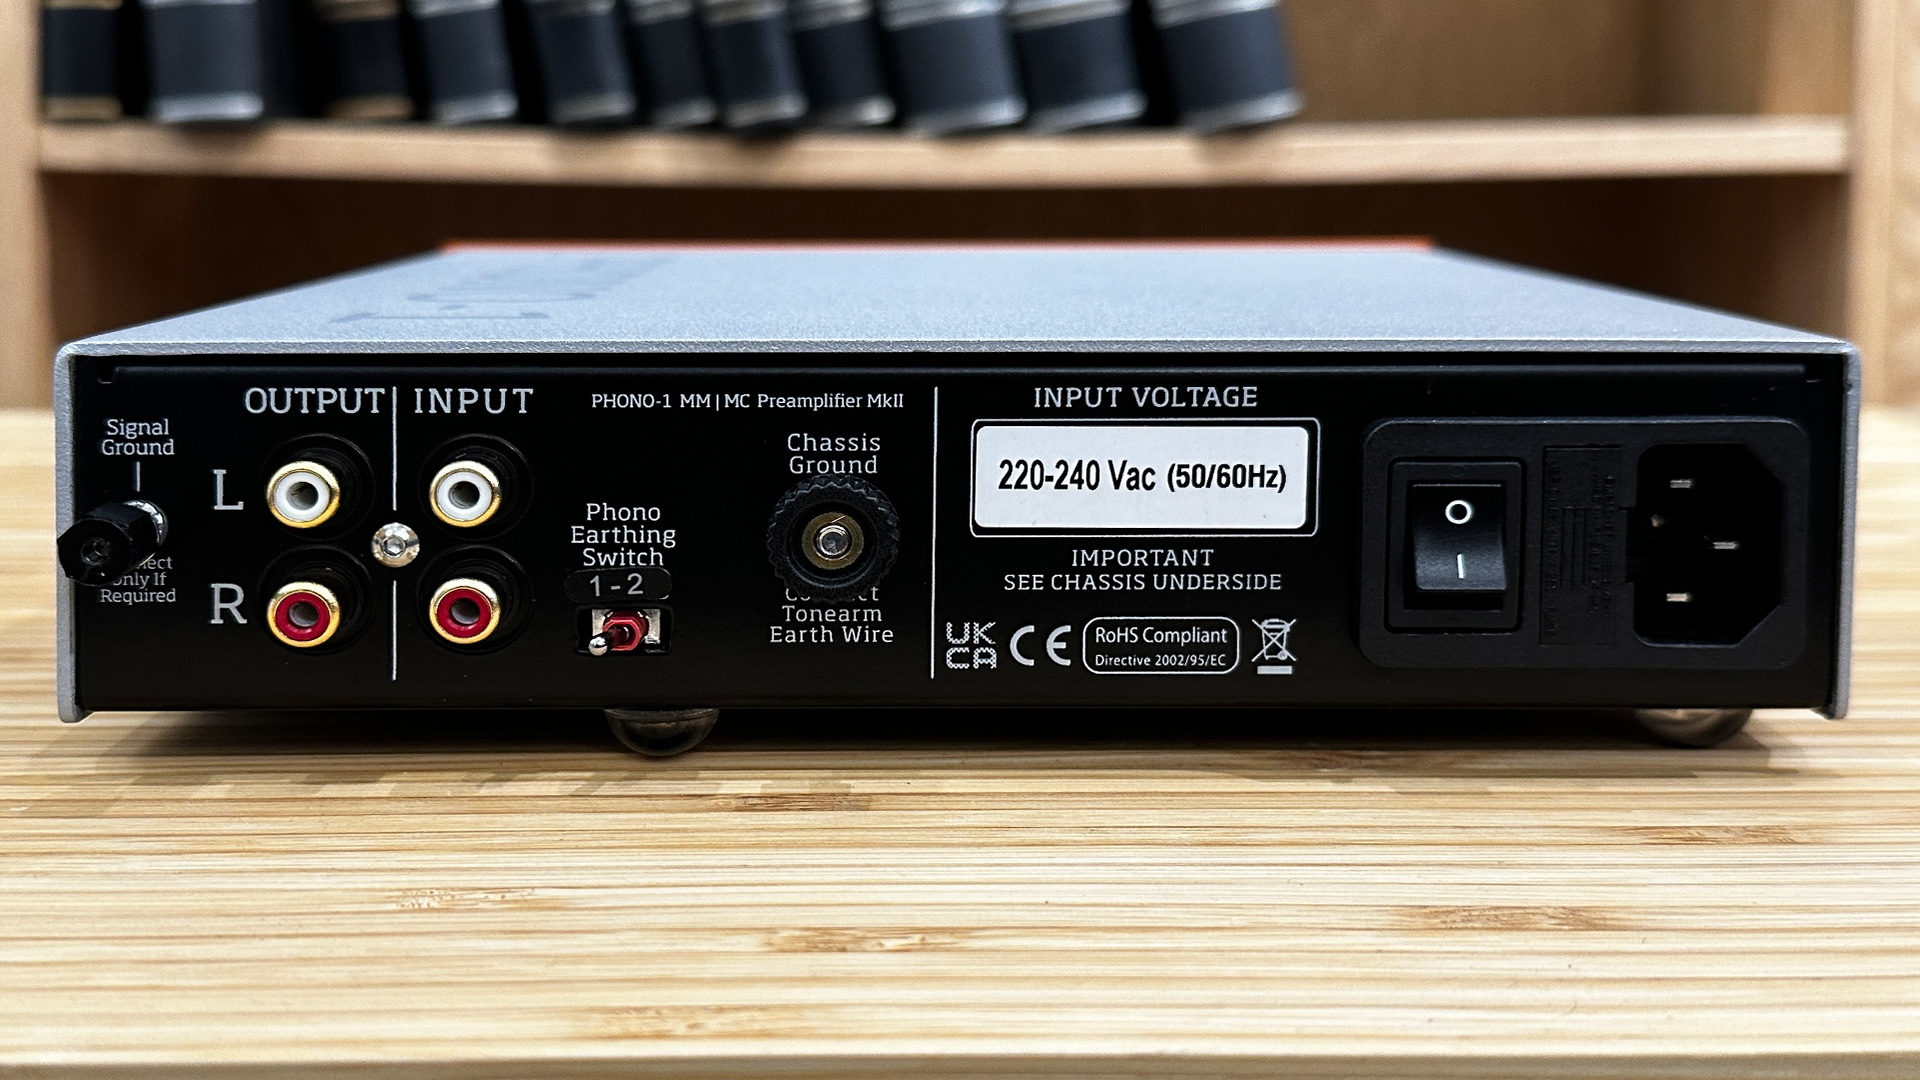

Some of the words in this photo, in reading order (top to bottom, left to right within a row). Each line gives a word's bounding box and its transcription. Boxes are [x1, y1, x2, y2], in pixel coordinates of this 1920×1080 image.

[245, 388, 385, 413] OUTPUT
[415, 388, 533, 414] INPUT
[592, 394, 671, 408] PHONO-1
[758, 393, 862, 411] Preamplifier
[867, 393, 903, 407] MkII
[1035, 387, 1122, 407] INPUT
[1132, 387, 1257, 407] VOLTAGE
[106, 418, 169, 439] Signal
[102, 439, 175, 456] Ground
[788, 433, 880, 451] Chassis
[790, 455, 877, 474] Ground
[999, 460, 1100, 490] 220-240
[1108, 460, 1155, 490] Vac
[1168, 464, 1286, 493] (50/60Hz)
[214, 469, 244, 510] L
[587, 503, 660, 521] Phono
[571, 525, 675, 549] Earthing
[582, 547, 665, 567] Switch
[1072, 549, 1213, 566] IMPORTANT
[155, 572, 166, 585] If
[1005, 575, 1044, 590] SEE
[1052, 574, 1145, 590] CHASSIS
[1153, 574, 1281, 590] UNDERSIDE
[100, 588, 176, 606] Required
[211, 583, 247, 624] R
[782, 606, 882, 622] Tonearm
[770, 625, 833, 643] Earth
[842, 625, 893, 642] Wire
[1096, 627, 1138, 643] RoHS
[1143, 627, 1227, 646] Compliant
[1096, 655, 1150, 666] Directive
[1155, 654, 1225, 666] 2002/95/EC
